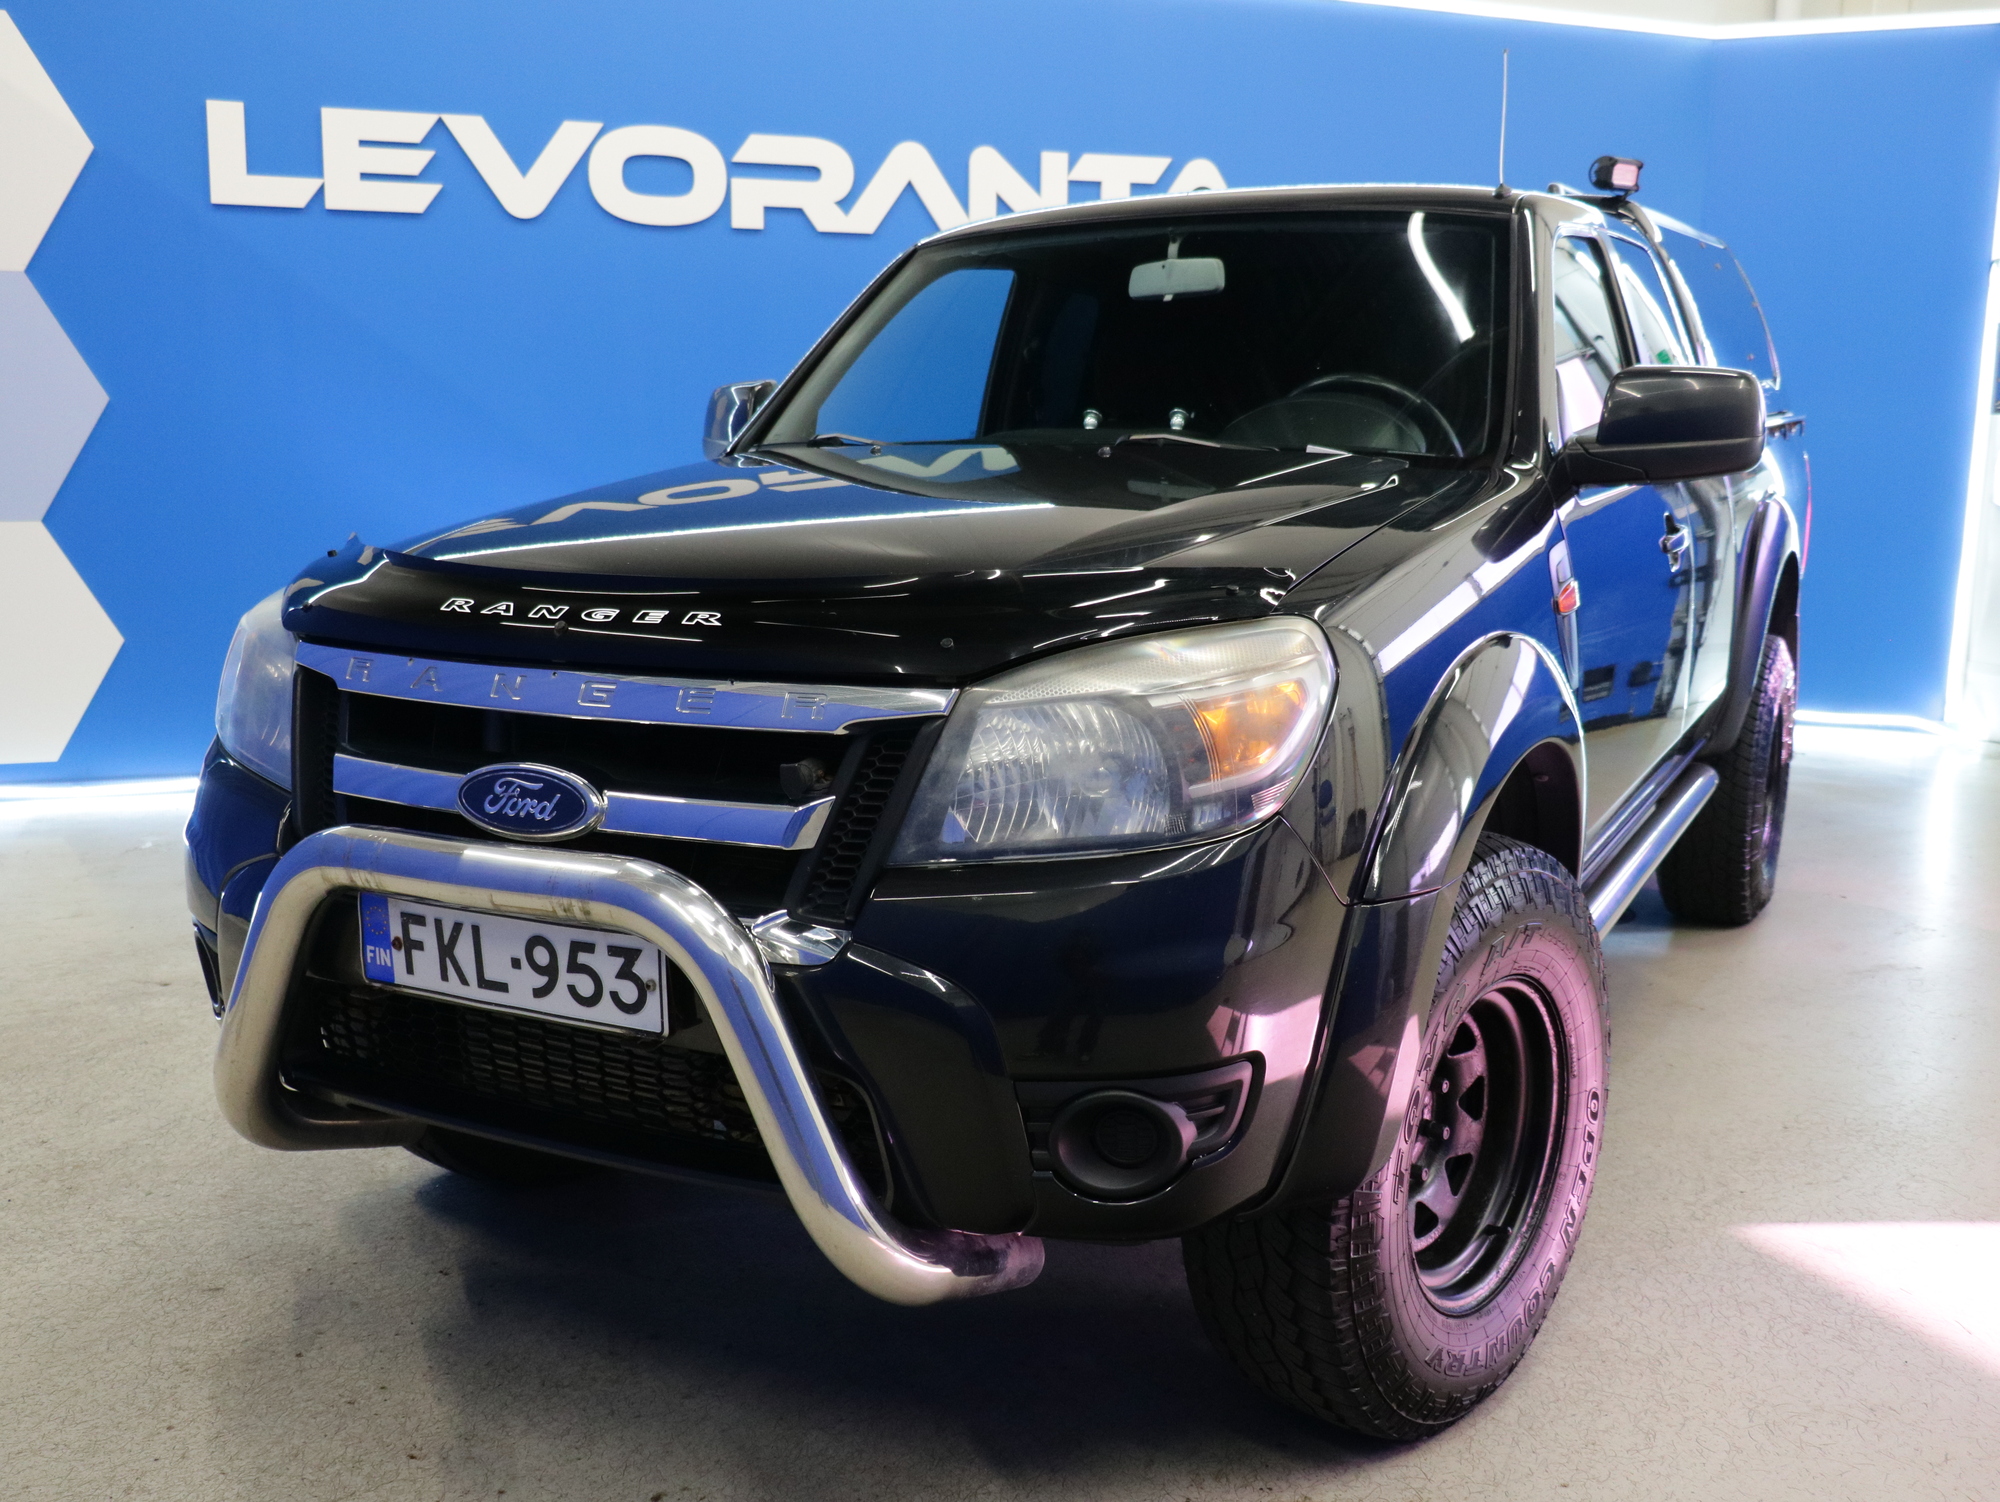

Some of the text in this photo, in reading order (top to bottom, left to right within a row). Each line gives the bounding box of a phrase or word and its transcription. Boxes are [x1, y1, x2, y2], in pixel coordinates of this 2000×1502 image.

[439, 597, 723, 628] RANGER
[346, 656, 827, 721] RANGER
[484, 776, 562, 822] Ford
[366, 944, 393, 968] FIN
[401, 911, 649, 1016] FKL-953
[1559, 1086, 1601, 1250] OPEN
[1424, 1257, 1557, 1378] COUNTRY
